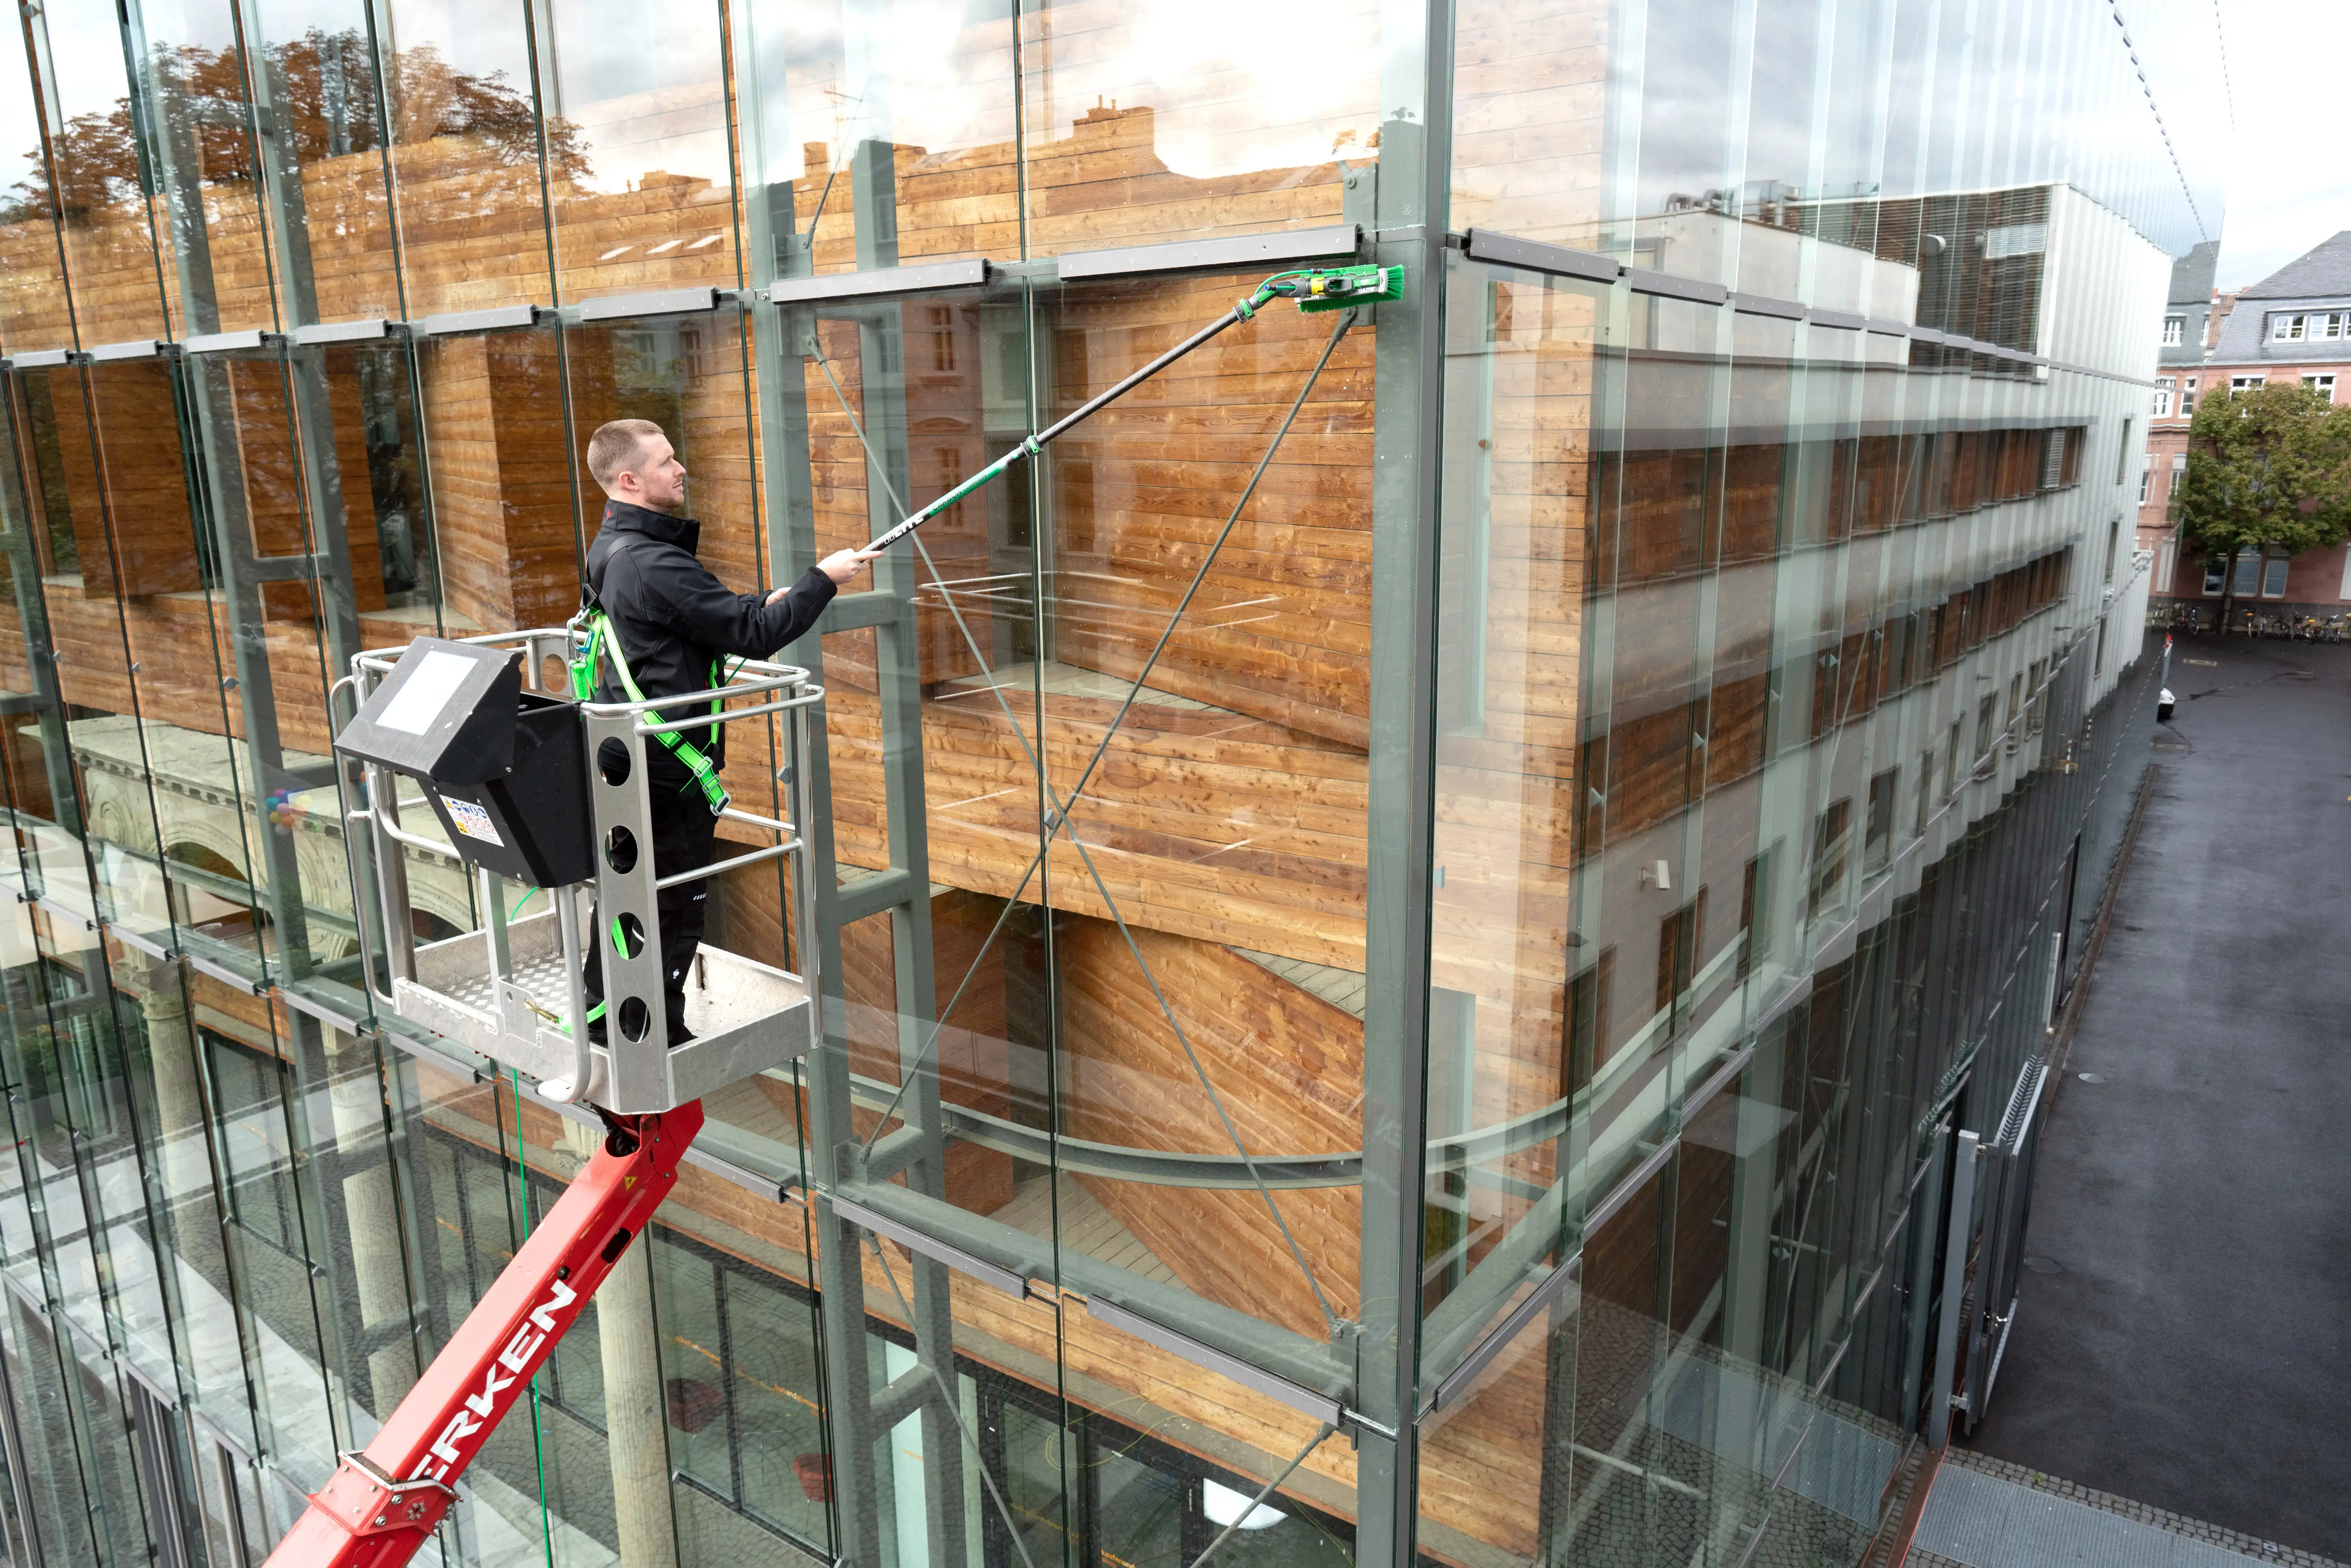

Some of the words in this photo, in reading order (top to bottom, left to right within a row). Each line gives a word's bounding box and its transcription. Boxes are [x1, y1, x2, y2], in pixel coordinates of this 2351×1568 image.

[933, 490, 962, 511] CARBON
[963, 474, 988, 492] COMPOSITE
[1101, 1548, 1136, 1568] kaufenund
